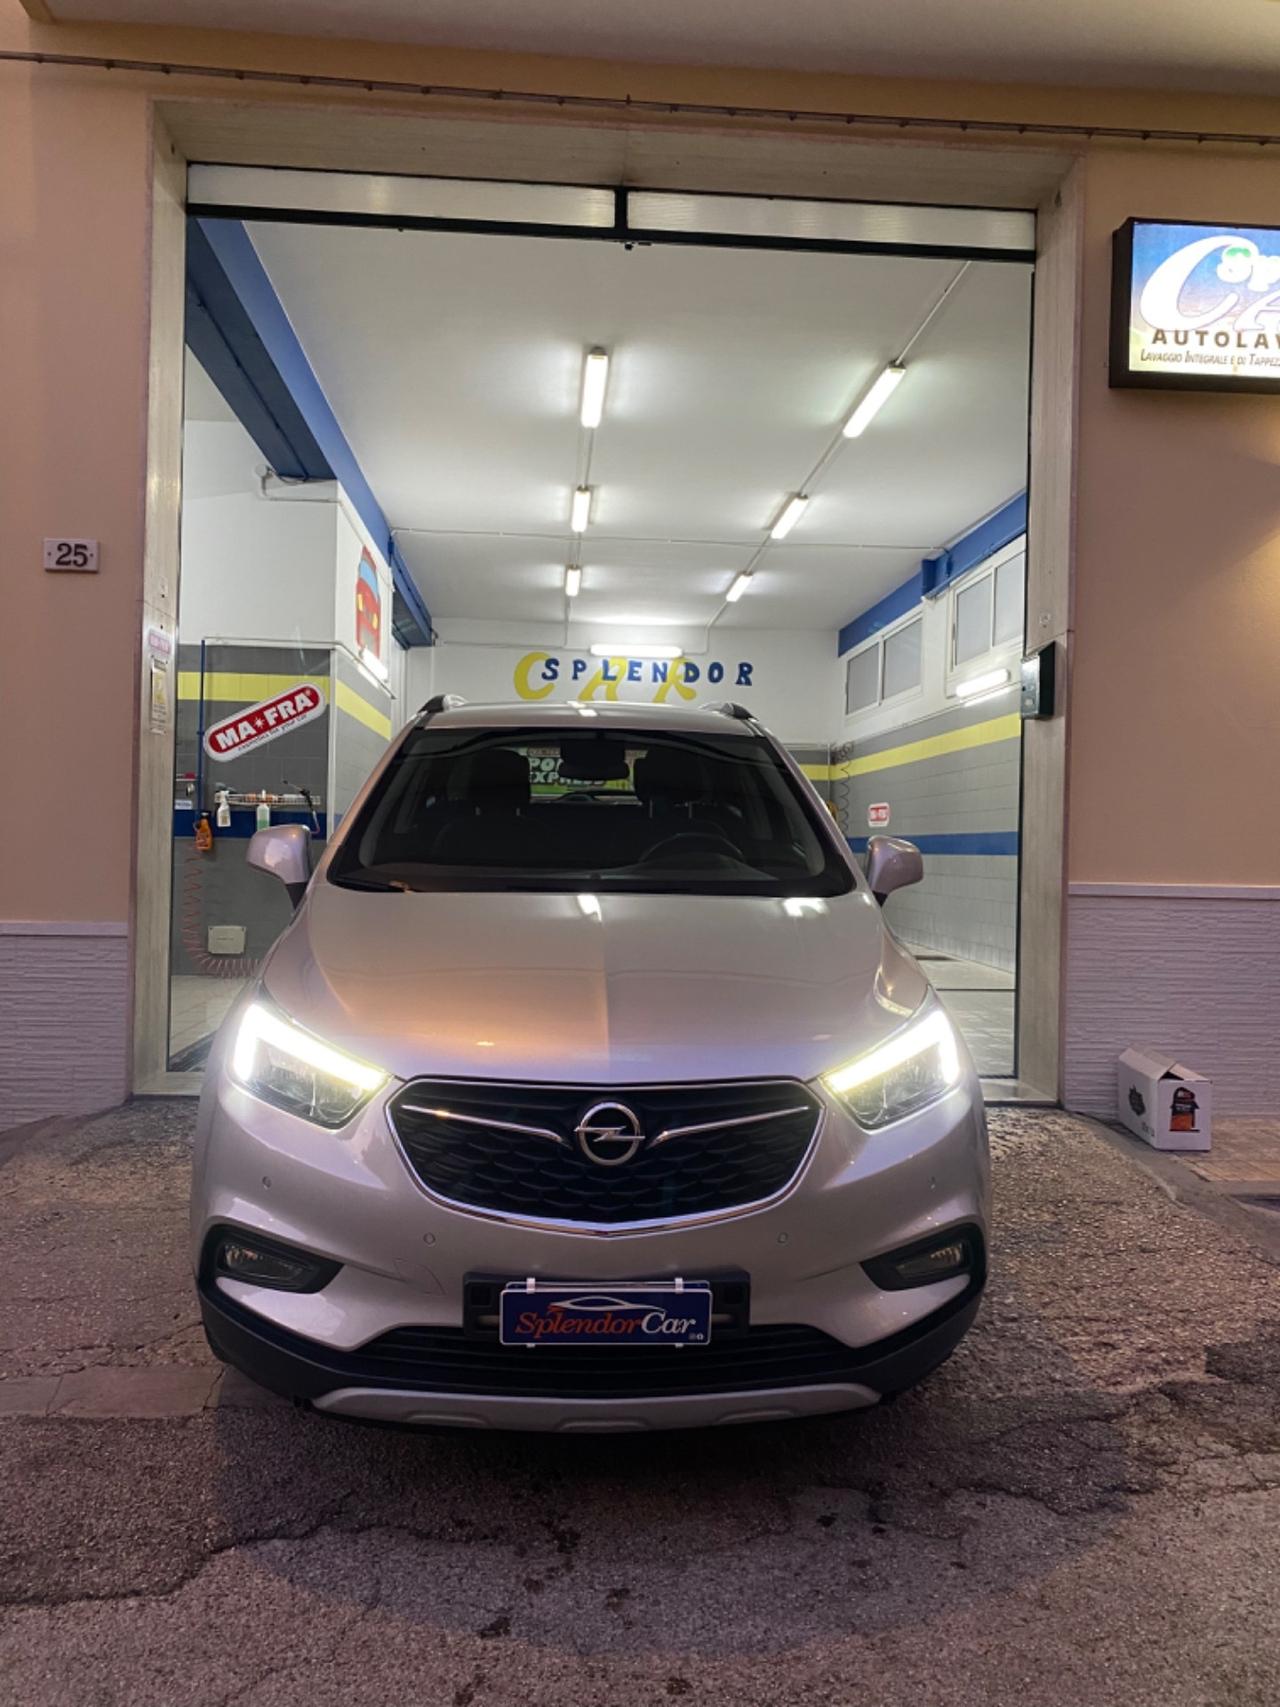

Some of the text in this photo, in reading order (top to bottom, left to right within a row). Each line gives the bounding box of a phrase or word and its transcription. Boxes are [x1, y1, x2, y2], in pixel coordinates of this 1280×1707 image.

[56, 543, 88, 567] 25
[513, 651, 697, 703] CAR
[541, 658, 753, 686] SPLENDOR
